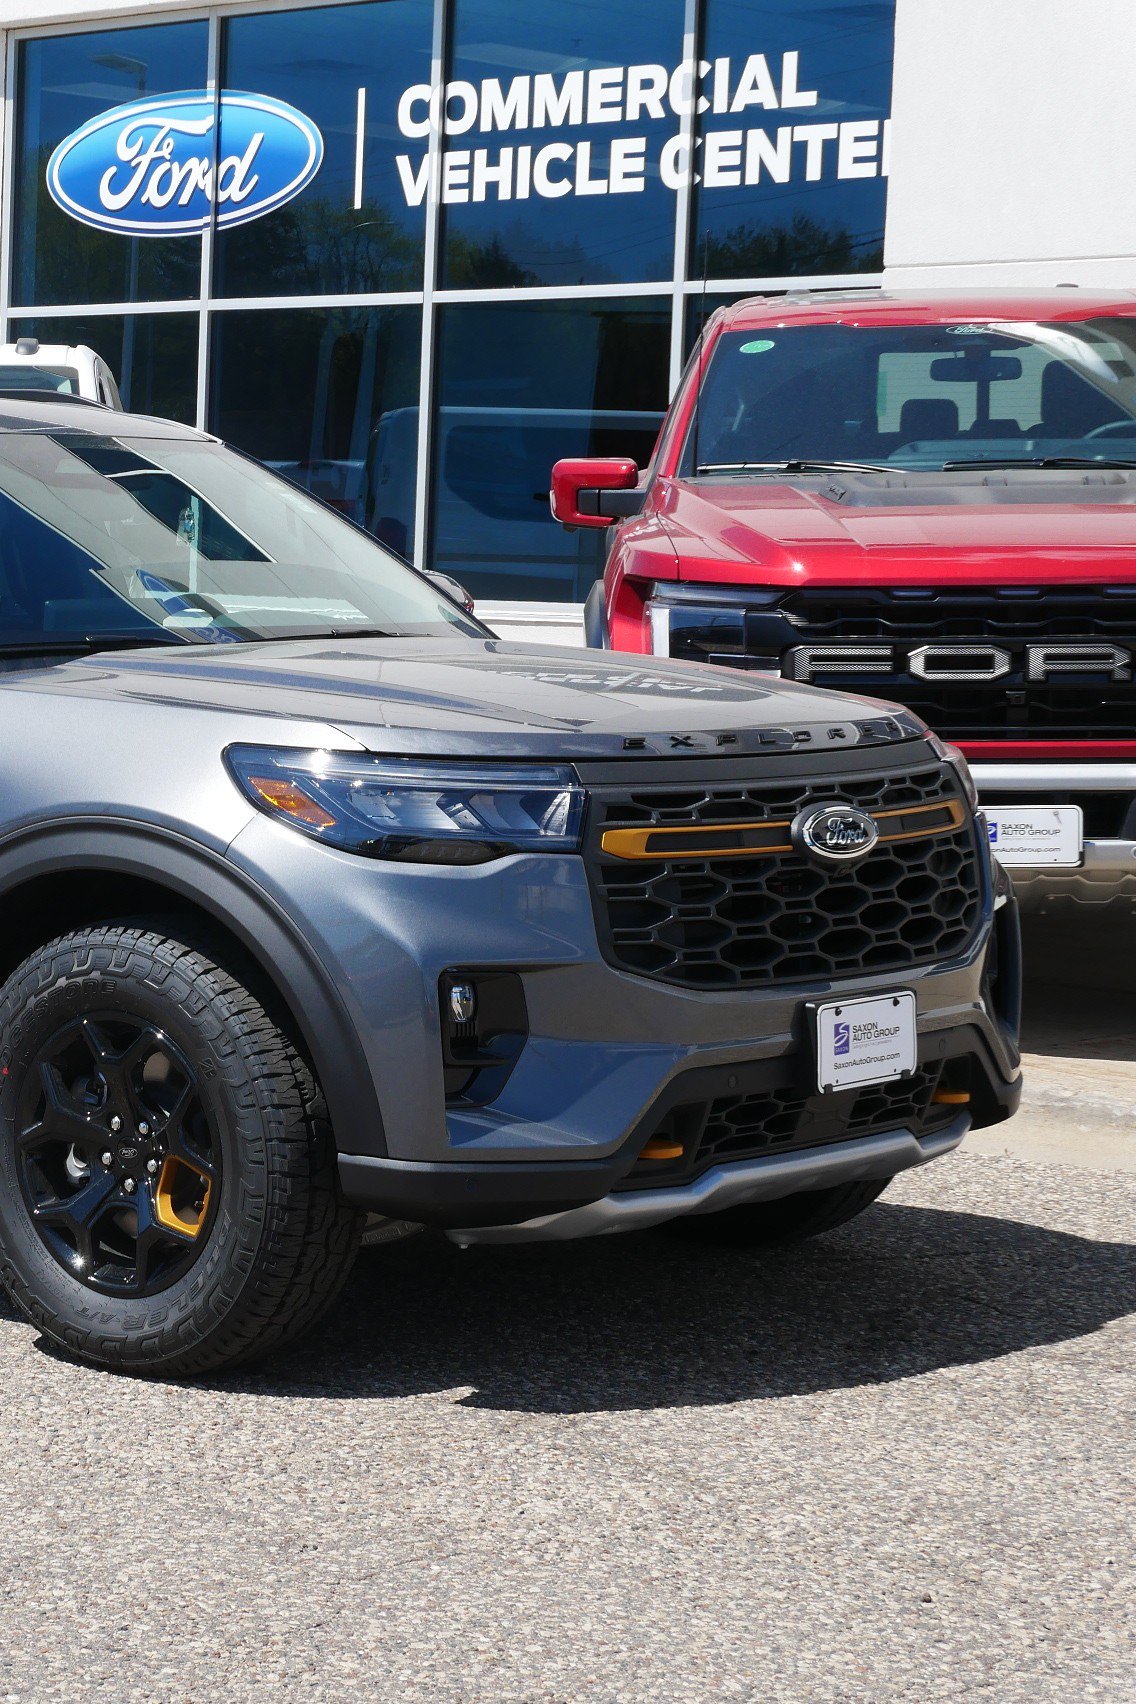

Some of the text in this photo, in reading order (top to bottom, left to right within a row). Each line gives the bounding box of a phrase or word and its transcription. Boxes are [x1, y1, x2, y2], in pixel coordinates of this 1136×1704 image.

[397, 51, 818, 138] COMMERCIAL
[99, 114, 264, 211] Ford
[395, 137, 647, 207] VEHICLE
[623, 720, 900, 749] EXPLORER
[826, 817, 865, 845] Ford
[853, 1022, 879, 1034] SAXON
[853, 1027, 900, 1042] AUTO GROUP
[834, 1053, 900, 1070] SaxonAutoGroup.com
